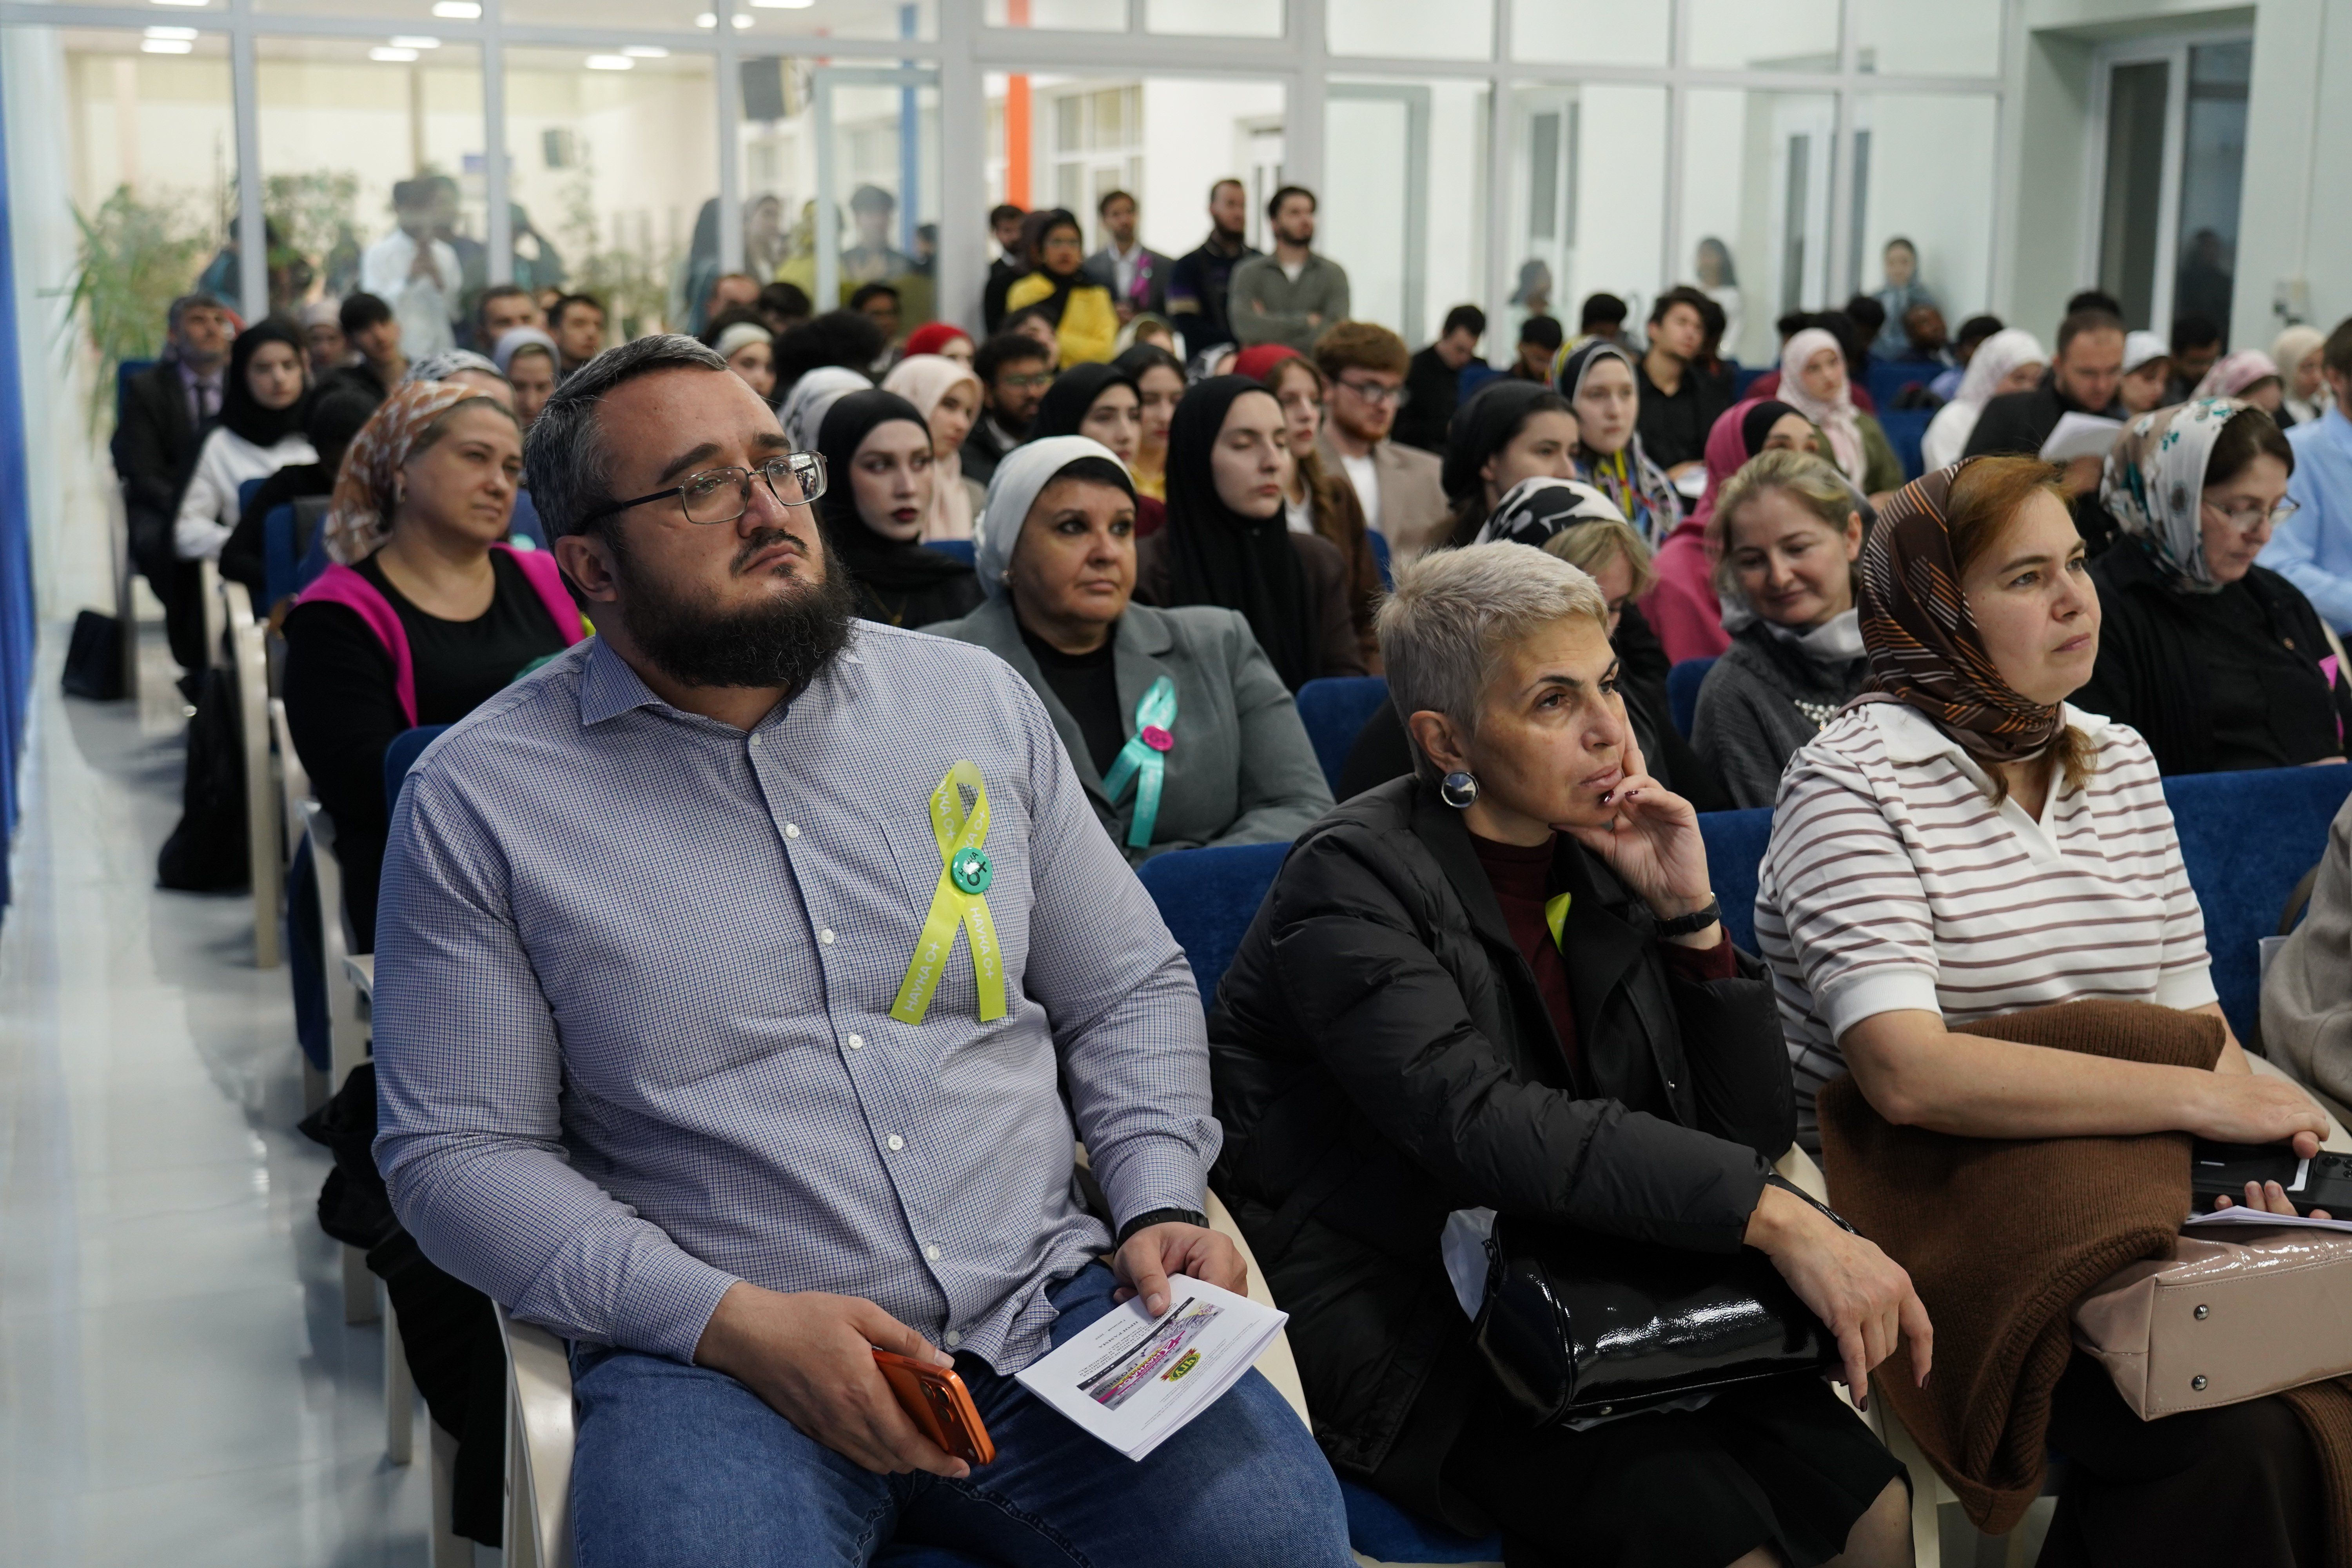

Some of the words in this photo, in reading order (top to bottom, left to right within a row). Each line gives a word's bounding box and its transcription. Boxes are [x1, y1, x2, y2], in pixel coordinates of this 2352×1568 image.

[970, 907, 991, 956] НАУКА
[904, 965, 933, 1012] НАУКА
[1098, 1321, 1139, 1348] ПРОГРАММА
[1094, 1363, 1138, 1396] ГРОЗНЫЙ
[1131, 1352, 1161, 1377] НАУКА
[1174, 1360, 1196, 1377] ЧГУ
